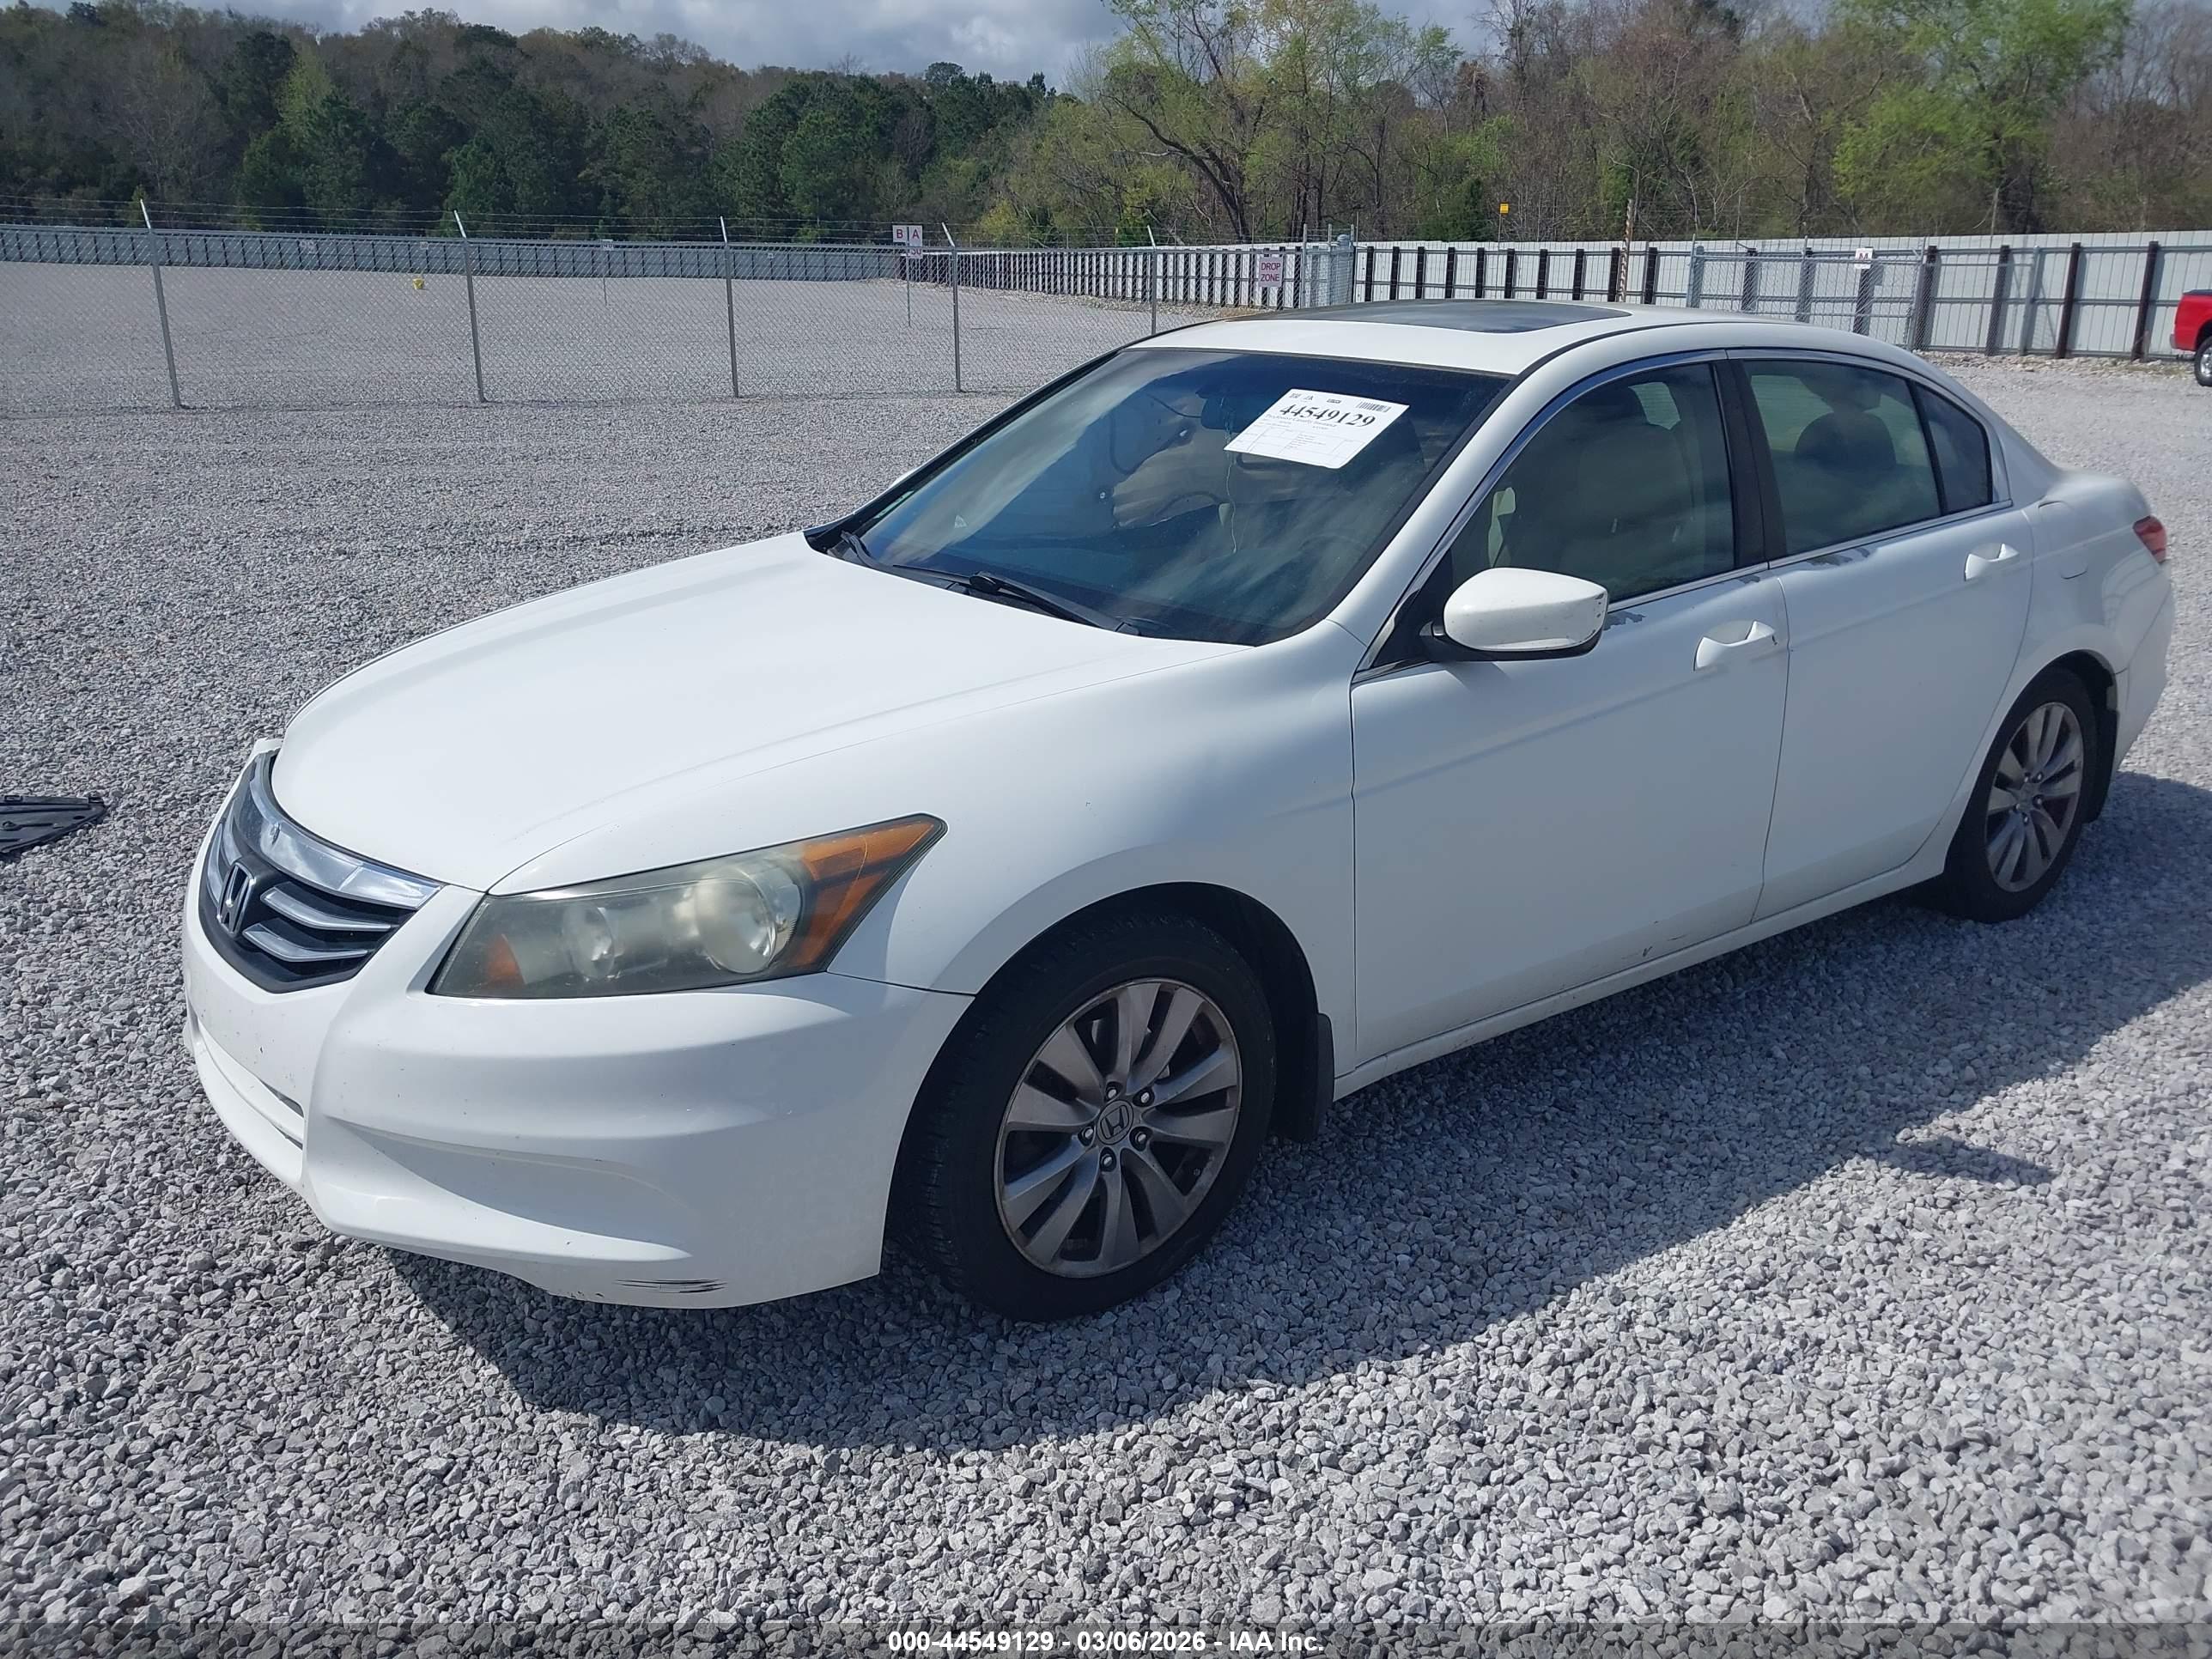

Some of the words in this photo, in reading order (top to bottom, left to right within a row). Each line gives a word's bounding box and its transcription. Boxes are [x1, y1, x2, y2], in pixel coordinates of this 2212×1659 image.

[896, 228, 903, 239] B
[912, 228, 920, 239] A
[1261, 273, 1280, 282] ZONE
[1279, 404, 1376, 427] 44549129
